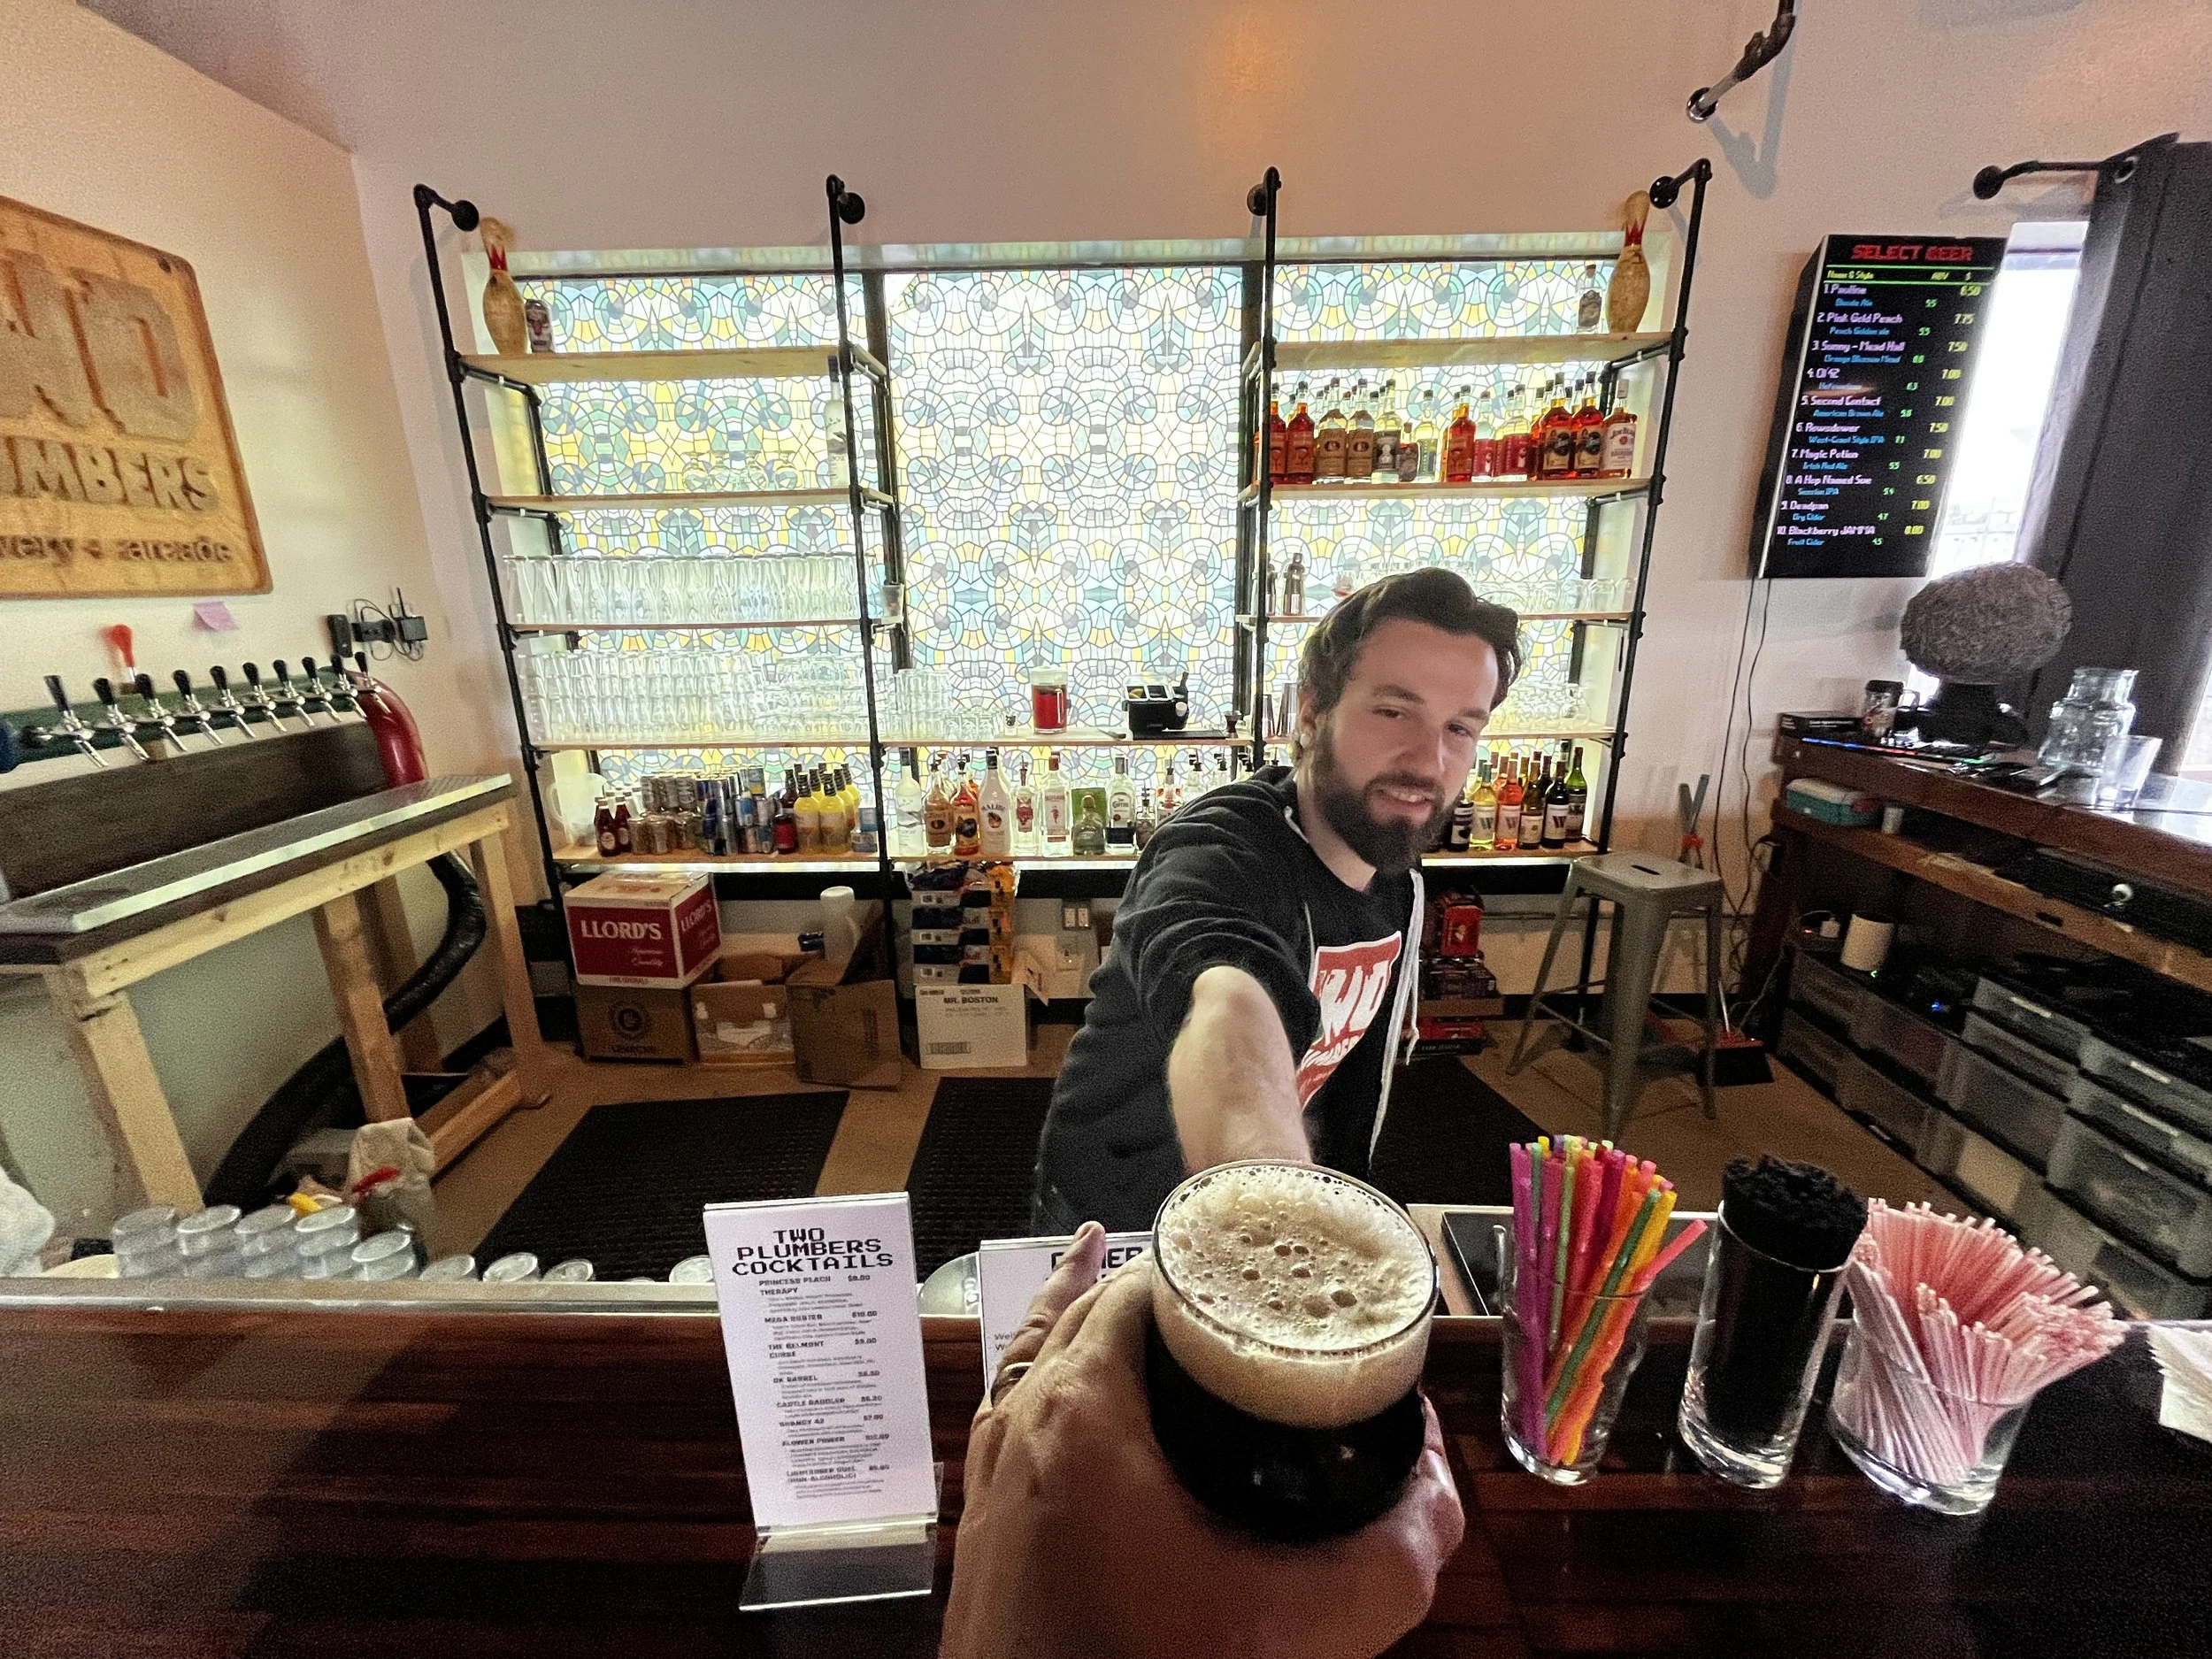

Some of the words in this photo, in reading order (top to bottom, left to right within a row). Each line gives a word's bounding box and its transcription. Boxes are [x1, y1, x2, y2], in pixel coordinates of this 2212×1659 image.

[1851, 244, 1923, 260] SELECT
[1924, 245, 1973, 261] BEER
[1831, 284, 1867, 295] Pauline
[1826, 312, 1849, 323] Pink
[1850, 312, 1872, 323] Gold
[1872, 312, 1902, 324] Peach
[1854, 326, 1878, 335] Golden
[1821, 340, 1850, 353] Sunny
[1859, 341, 1886, 351] Mead
[1886, 341, 1906, 351] Hall
[1810, 396, 1844, 405] Second
[1845, 396, 1882, 406] Contact
[1800, 449, 1828, 460] Magic
[1829, 449, 1859, 458] Potion
[0, 434, 219, 513] MBERS
[1794, 475, 1802, 485] A
[1804, 475, 1821, 486] Hop
[1822, 475, 1854, 485] Named
[1855, 474, 1873, 485] Sue
[1789, 500, 1830, 511] Deadpan
[1792, 513, 1806, 522] Dry
[1788, 526, 1840, 536] Blackberry
[580, 919, 663, 941] LLORD'S
[773, 1227, 826, 1245] TWO
[737, 1238, 882, 1262] PLUMBERS
[732, 1253, 894, 1276] COCKTAILS
[759, 1278, 802, 1286] PRINCESS
[803, 1275, 832, 1284] PEACH
[764, 1315, 788, 1324] MEGA
[777, 1400, 807, 1409] CASTLE
